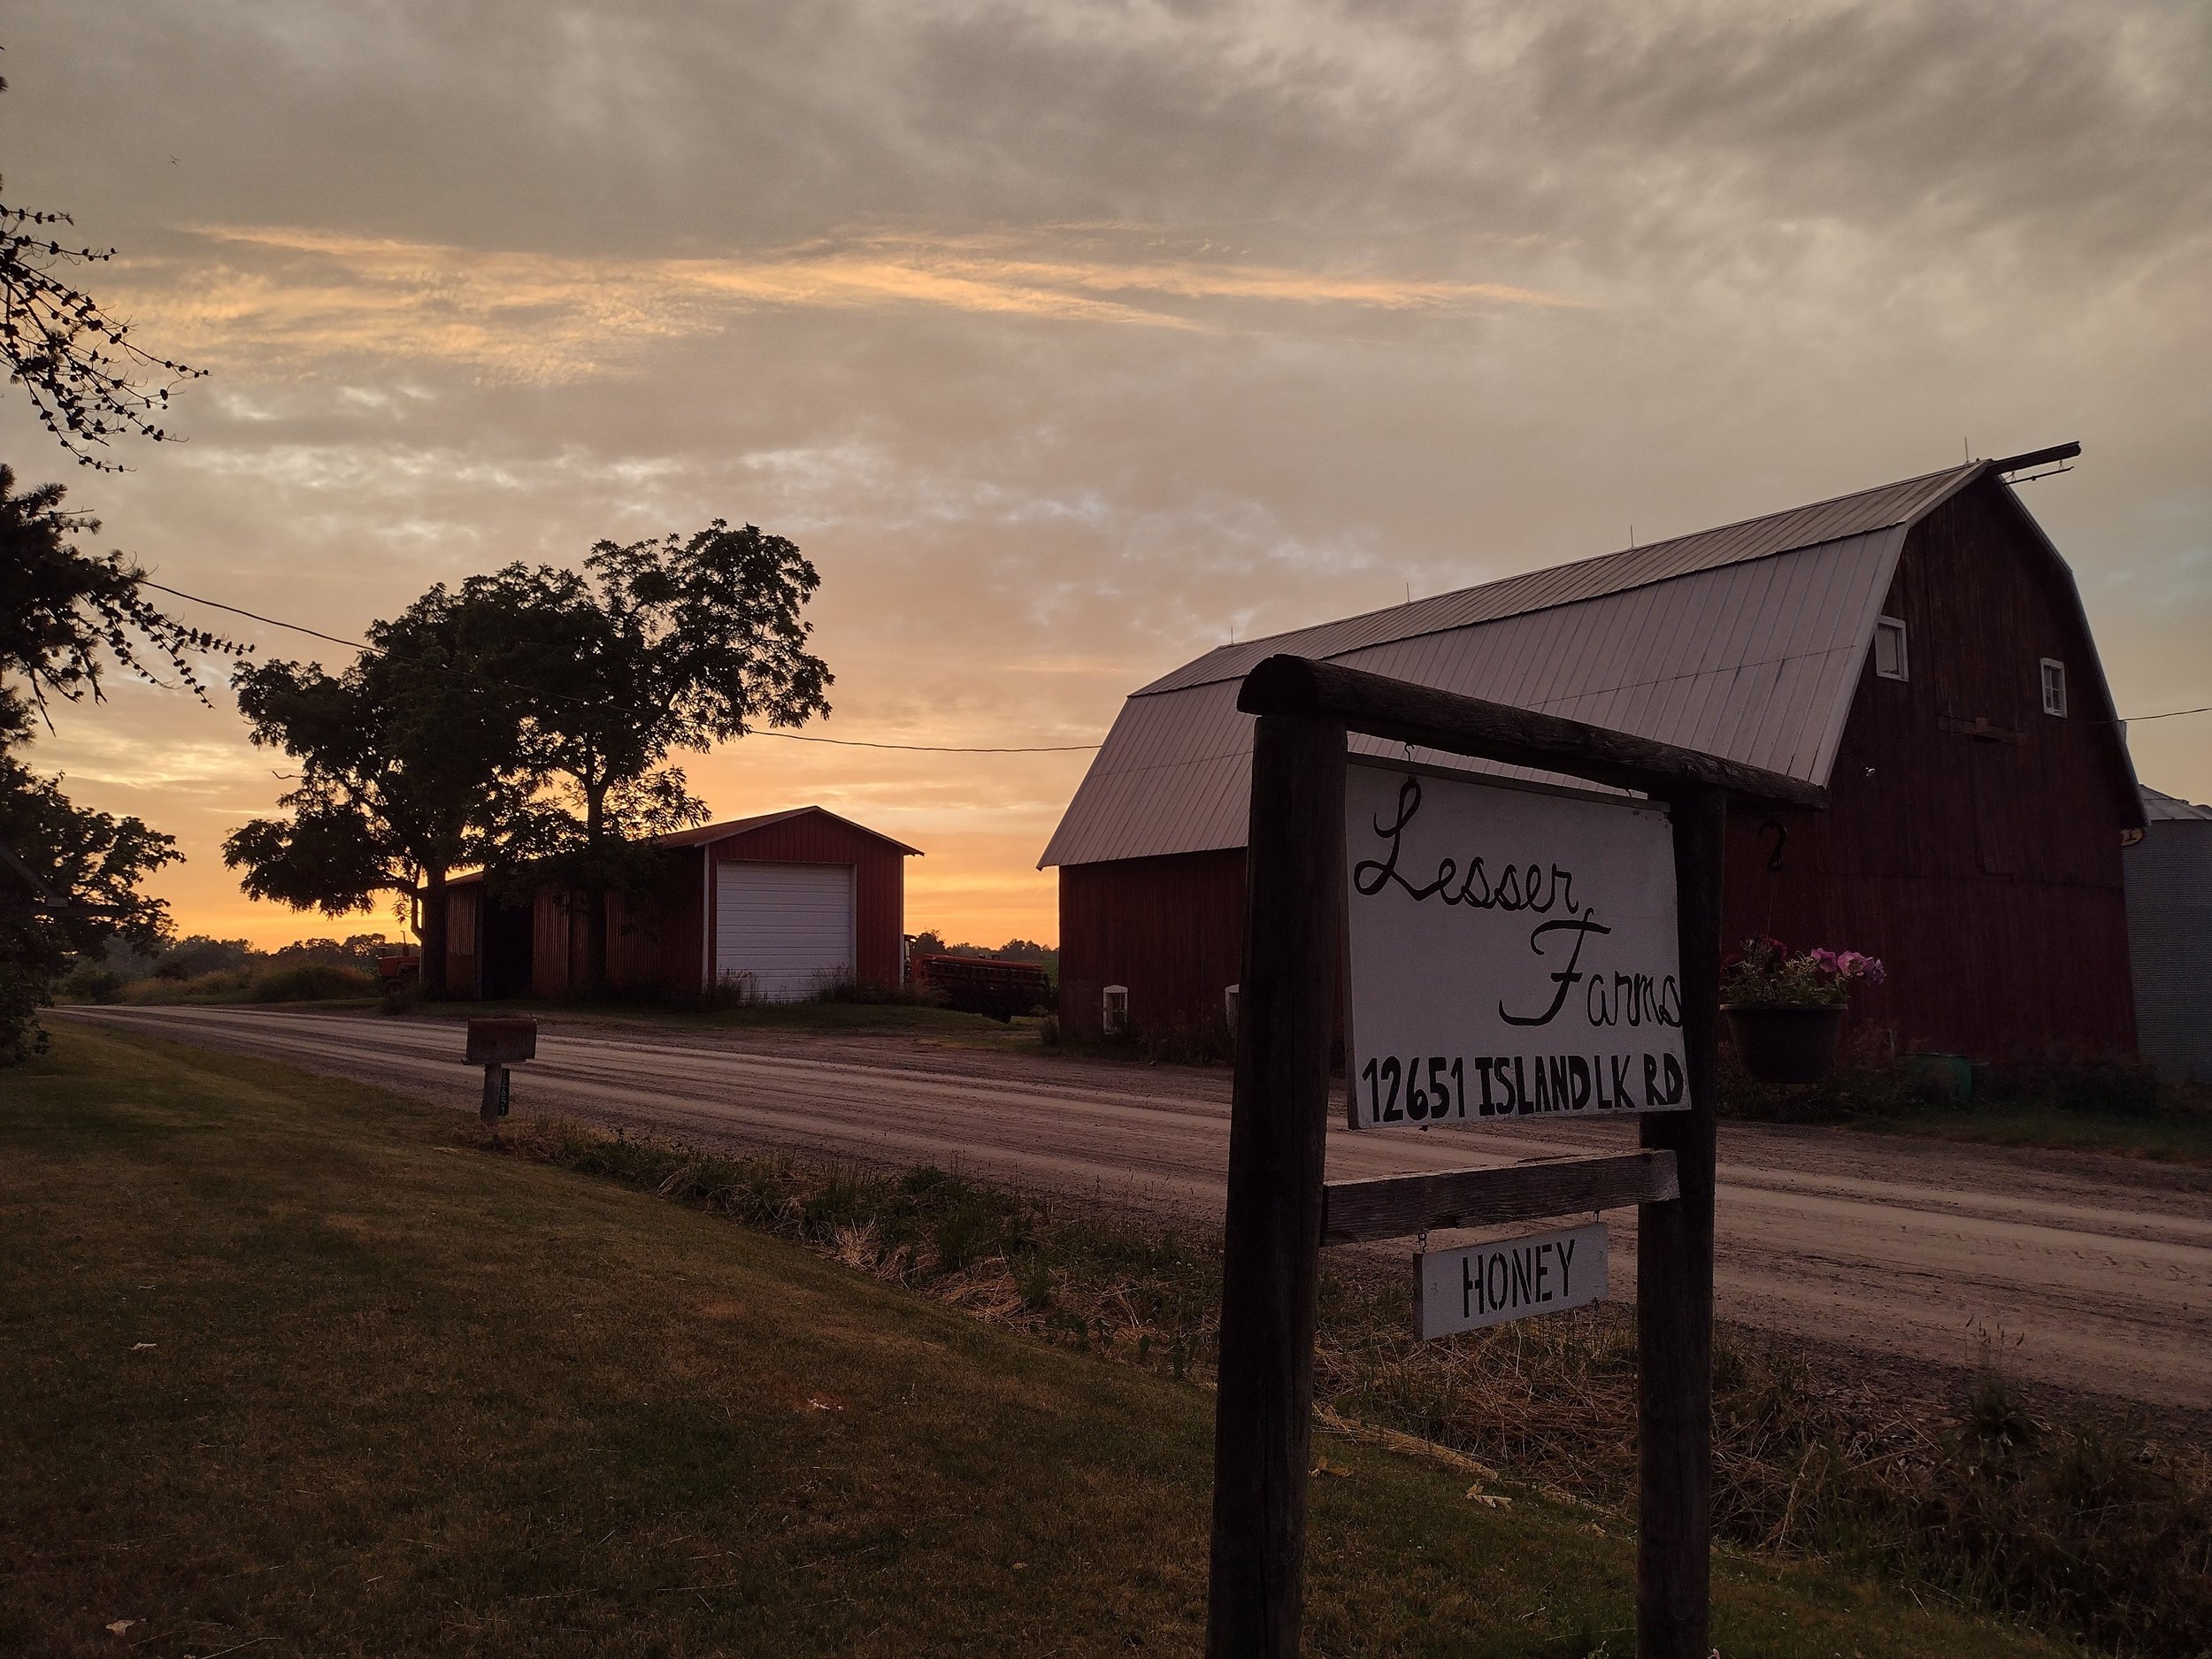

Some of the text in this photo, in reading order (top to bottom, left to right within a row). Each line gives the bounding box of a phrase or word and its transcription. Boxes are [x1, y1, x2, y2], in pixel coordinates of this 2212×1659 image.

[1354, 775, 1578, 914] Lesser
[1499, 908, 1682, 1027] Farms
[1362, 1056, 1465, 1123] 12651
[1644, 1053, 1684, 1106] RD
[1463, 1239, 1575, 1317] HONEY
